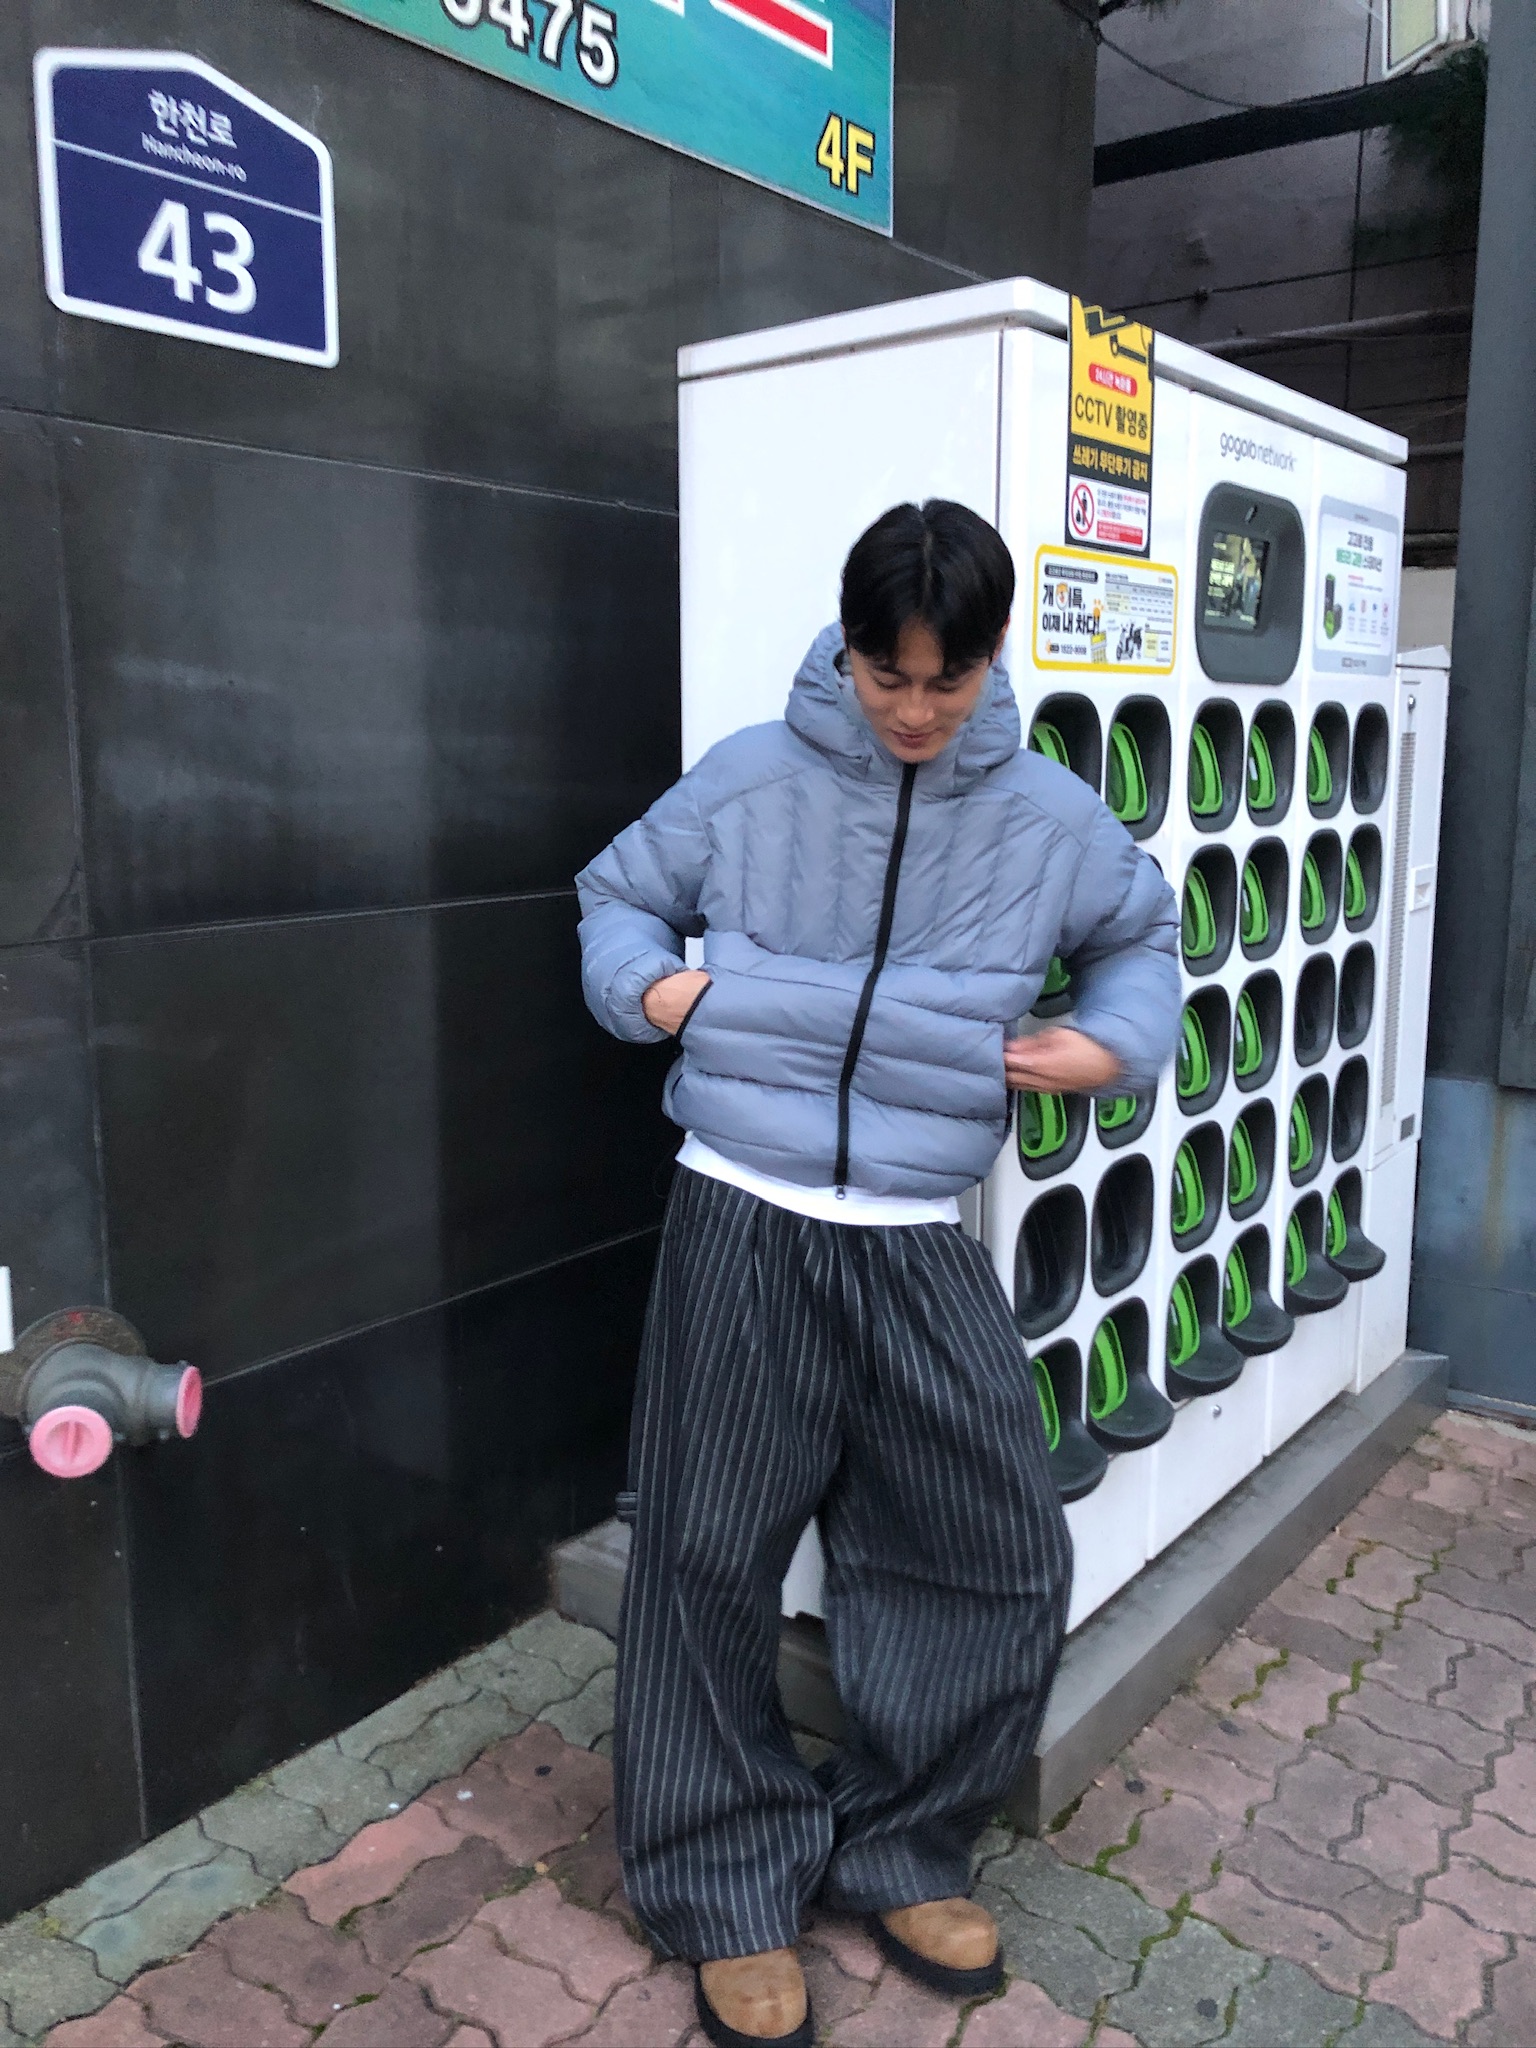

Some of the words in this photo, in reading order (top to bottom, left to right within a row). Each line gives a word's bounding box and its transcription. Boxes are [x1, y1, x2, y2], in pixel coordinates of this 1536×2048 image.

[148, 88, 238, 149] 한천로
[141, 132, 248, 183] Hancheon-ro
[816, 112, 875, 196] 4F
[137, 198, 258, 315] 43
[1075, 394, 1113, 428] CCTV
[1115, 405, 1148, 441] 촬영중
[1072, 443, 1099, 471] 쓰레기
[1099, 454, 1132, 480] 무단투기
[1042, 613, 1061, 632] 이제
[1062, 611, 1074, 635] 내
